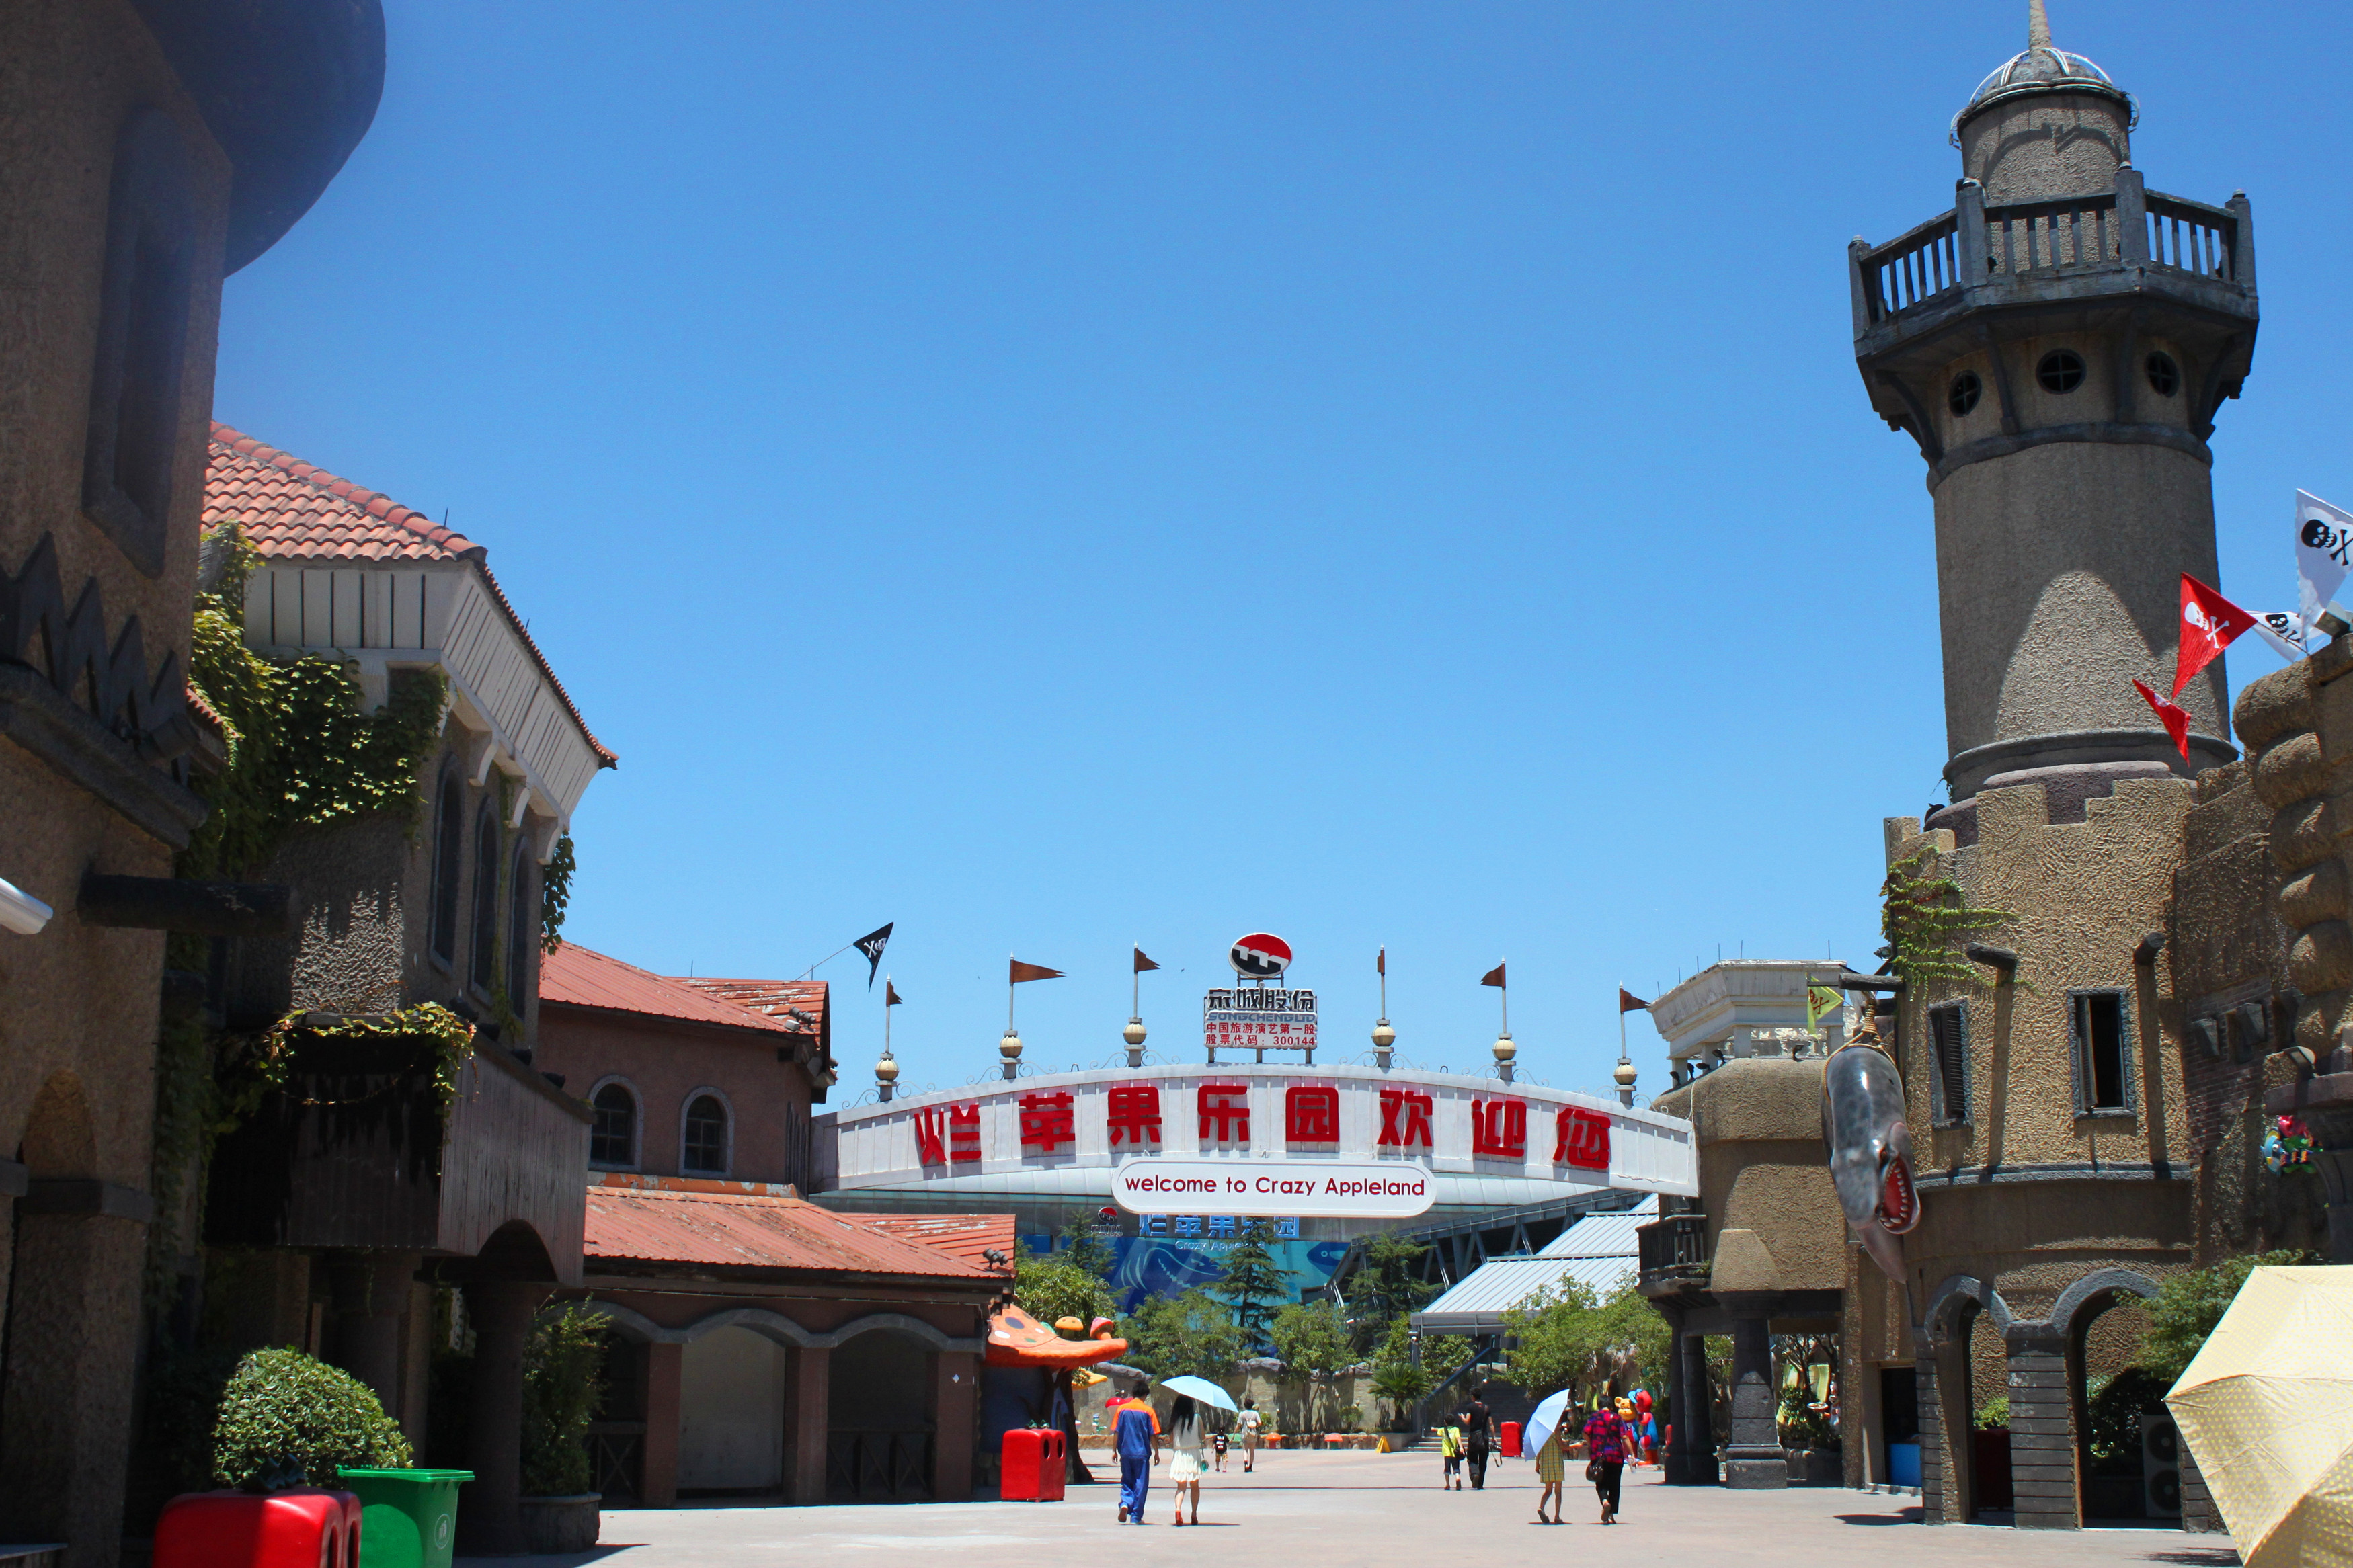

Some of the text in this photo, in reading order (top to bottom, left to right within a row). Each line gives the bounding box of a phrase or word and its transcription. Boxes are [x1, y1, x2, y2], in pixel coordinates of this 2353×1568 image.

[1206, 1022, 1315, 1035] 中国旅游演艺第一股
[1273, 1036, 1315, 1046] 300144
[914, 1085, 1611, 1169] 烂苹果乐园欢迎您
[1125, 1175, 1425, 1197] welcome to Crazy Appleland
[1175, 1240, 1207, 1251] Crazy
